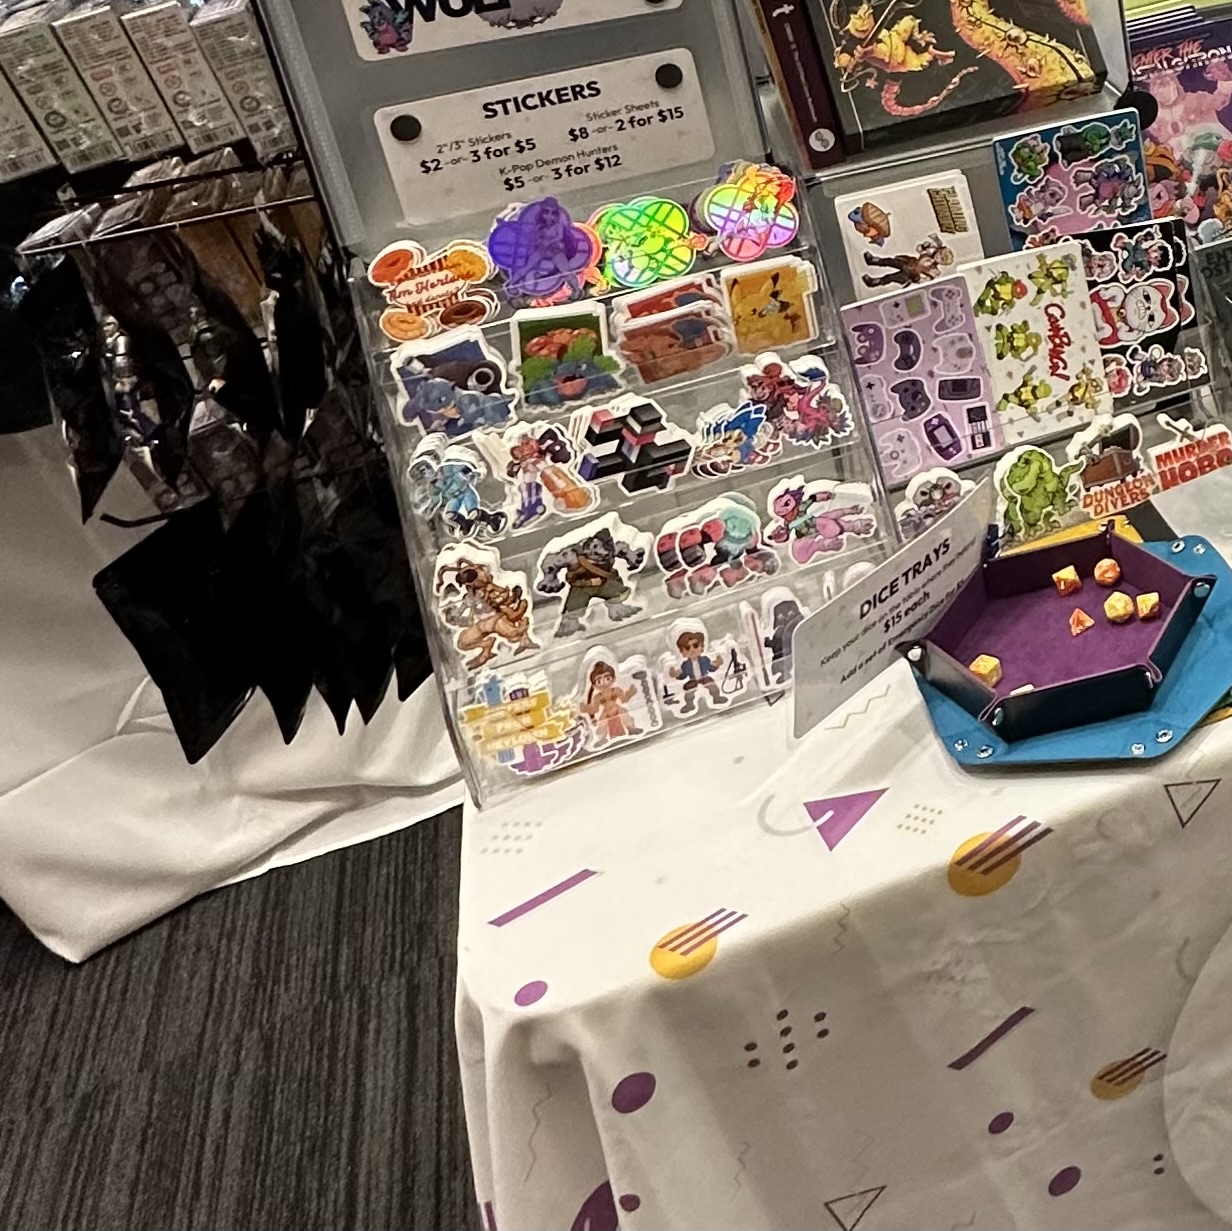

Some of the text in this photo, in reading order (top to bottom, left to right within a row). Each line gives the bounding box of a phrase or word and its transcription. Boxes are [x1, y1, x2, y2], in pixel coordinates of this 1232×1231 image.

[481, 80, 602, 119] STICKERS
[585, 100, 660, 122] Sticker Sheets
[468, 131, 512, 147] Stickers
[568, 106, 685, 142] $8 2 for $15
[420, 137, 536, 174] $2 3 for $5
[499, 142, 618, 176] K-Pop Demon Hunters
[503, 153, 622, 192] $5 3 for $12
[1155, 431, 1232, 468] MURDER
[1082, 474, 1157, 509] DUNGEON
[1093, 487, 1151, 517] DIVERS
[859, 577, 900, 620] DICE
[901, 537, 951, 586] TRAYS
[883, 590, 931, 634] $15 each
[820, 646, 841, 667] Keep
[840, 667, 857, 684] Add
